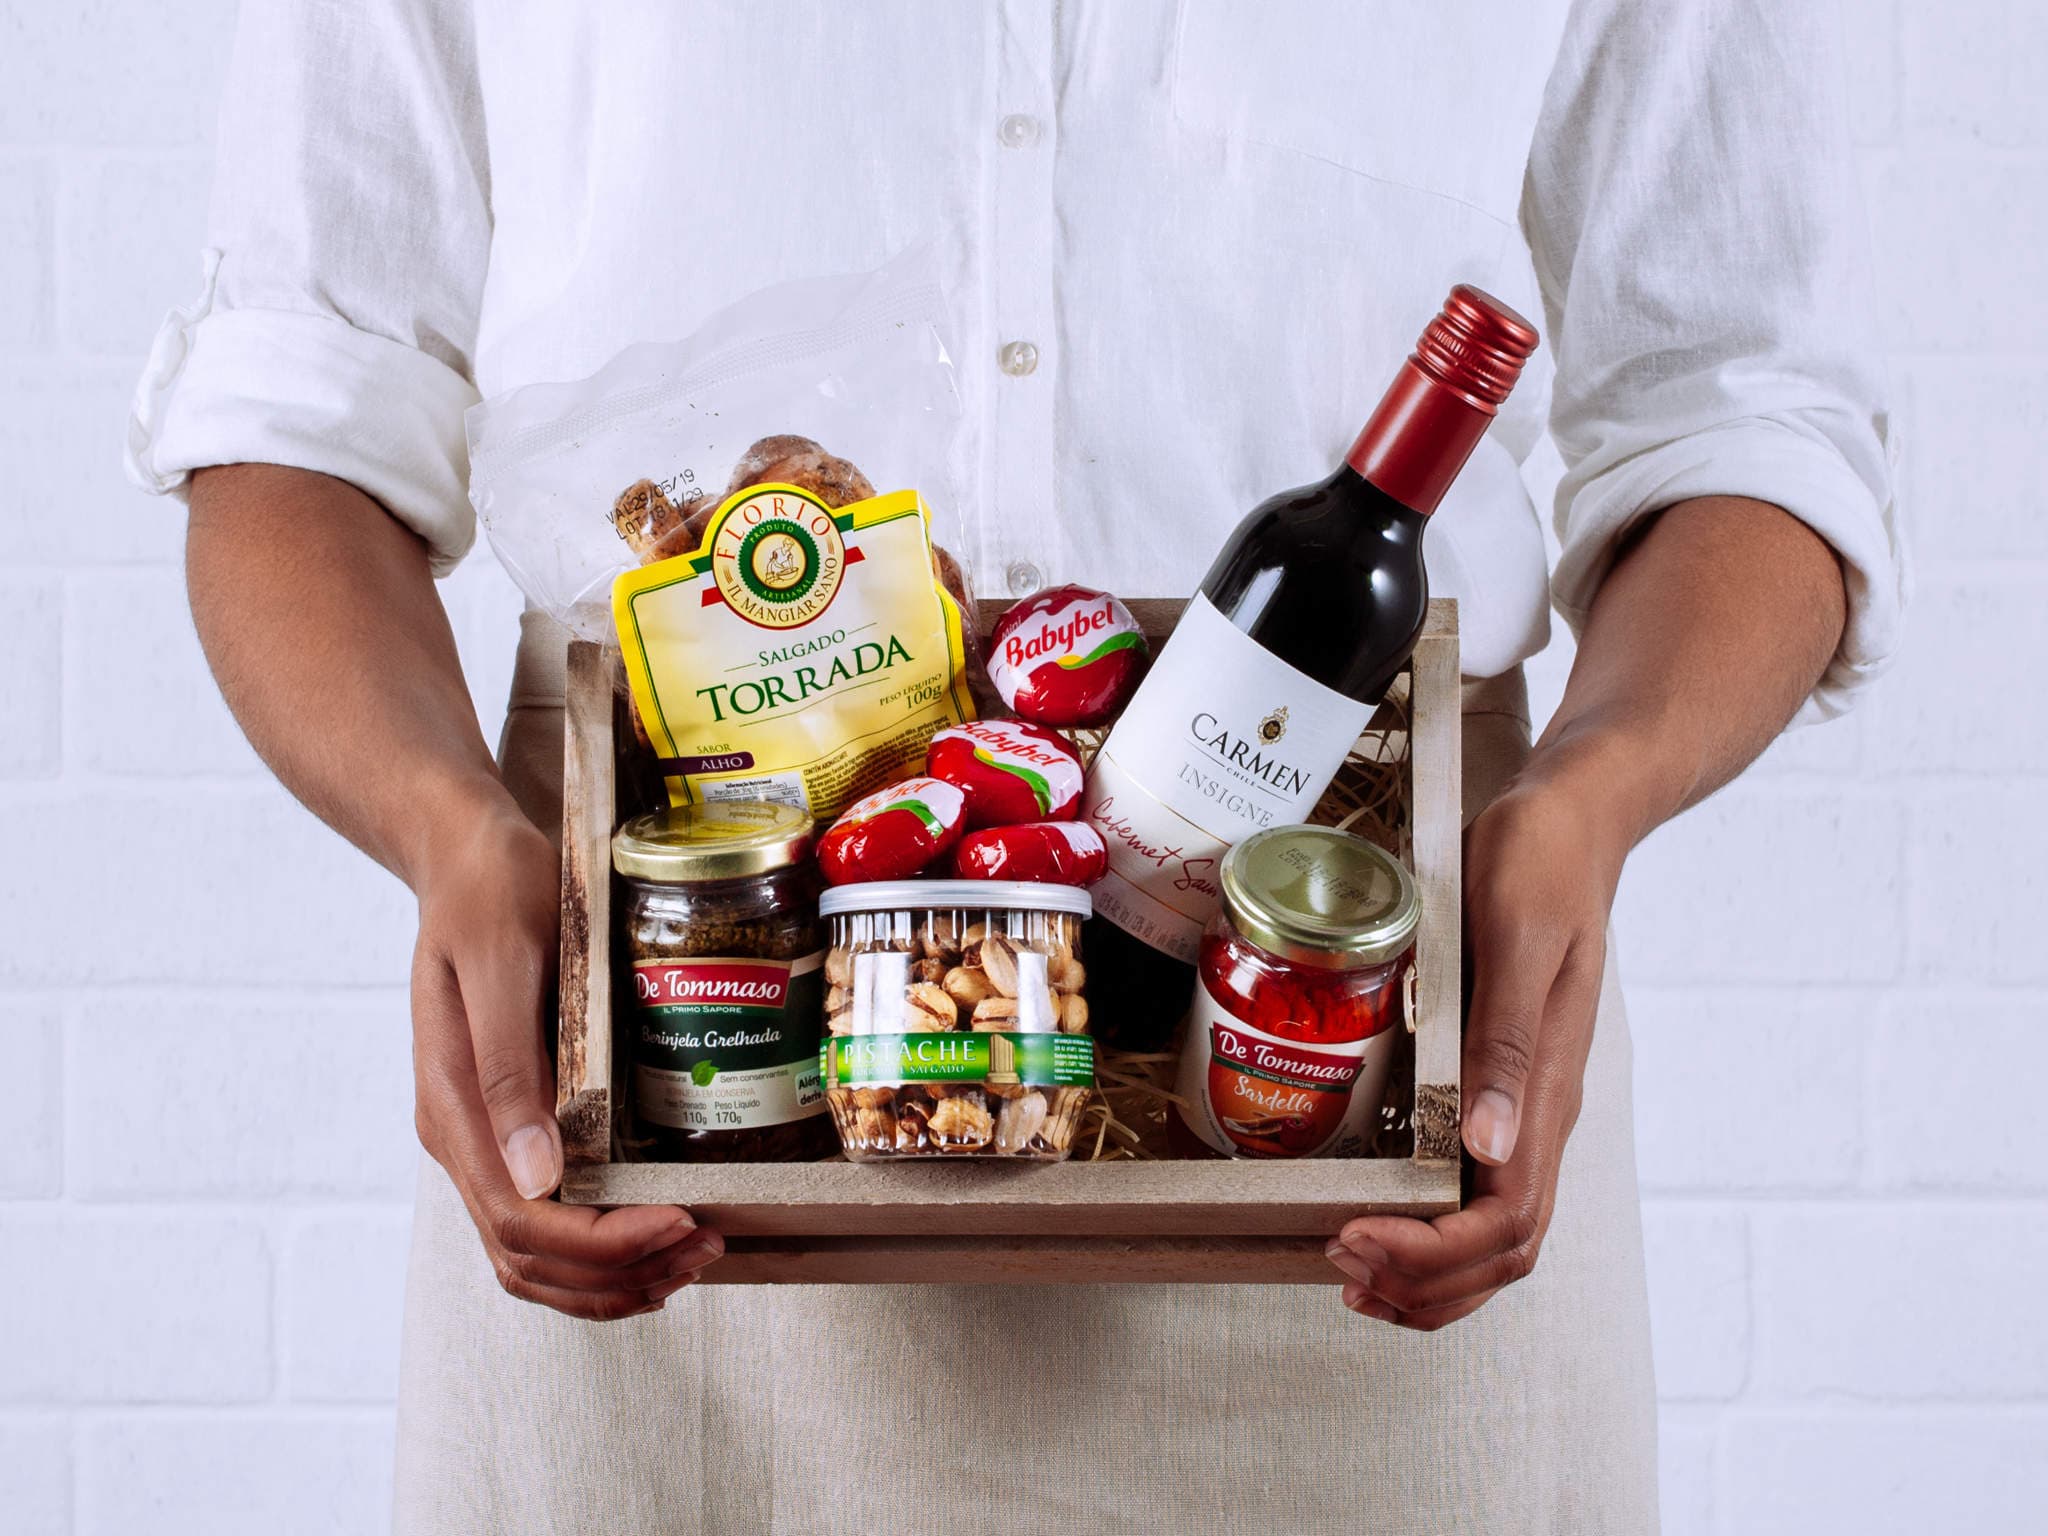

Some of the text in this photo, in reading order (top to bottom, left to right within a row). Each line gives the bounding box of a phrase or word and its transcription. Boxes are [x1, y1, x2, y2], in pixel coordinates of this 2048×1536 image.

[616, 516, 642, 541] LOT
[717, 497, 831, 560] FLORIO
[749, 523, 794, 543] PRODUTO
[741, 597, 817, 622] MANGIAR
[814, 557, 838, 602] SANO
[758, 629, 846, 667] SALGADO
[1005, 601, 1115, 671] Babybel
[696, 634, 915, 723] TORRADA
[879, 691, 901, 706] PESO
[907, 684, 942, 709] 100g
[696, 743, 732, 754] SABOR
[953, 721, 1068, 766] Babybel
[1191, 712, 1312, 796] CARMEN
[701, 757, 743, 770] ALHO
[1226, 767, 1256, 787] CHILE
[1177, 762, 1274, 829] INSIGNE
[1092, 796, 1184, 867] Cabernet
[633, 969, 781, 1000] De Tommaso
[672, 1006, 700, 1014] PRIMO
[701, 1005, 743, 1014] SAPORE
[703, 1027, 782, 1049] Grelhada
[844, 1039, 977, 1065] PISTACHE
[1219, 1031, 1354, 1081] De Tommaso
[720, 1069, 789, 1083] Sem conservantes
[910, 1064, 965, 1074] SALGADO
[714, 1101, 732, 1110] Peso
[1233, 1075, 1318, 1113] Sardella
[683, 1111, 742, 1125] 110g 170g
